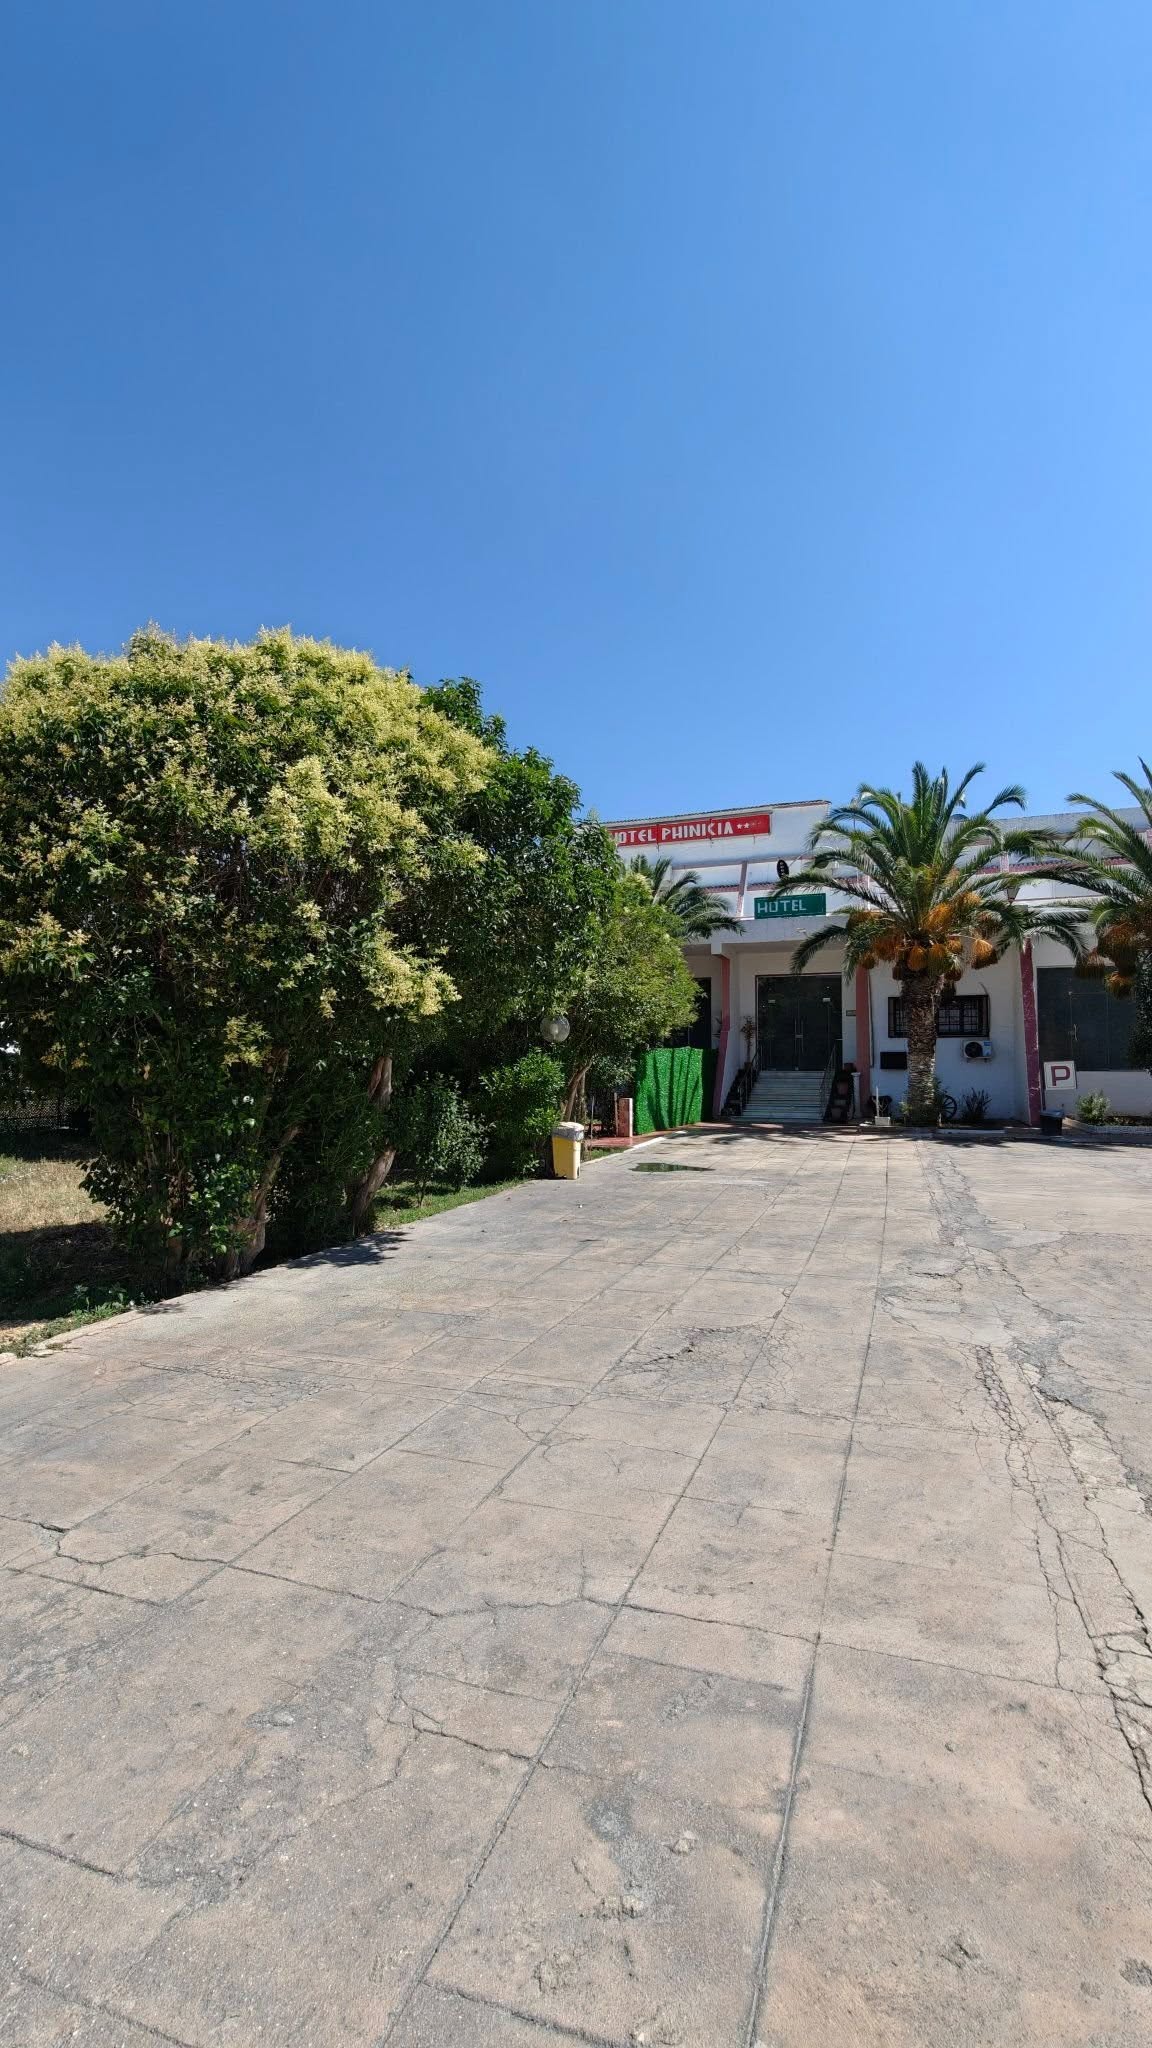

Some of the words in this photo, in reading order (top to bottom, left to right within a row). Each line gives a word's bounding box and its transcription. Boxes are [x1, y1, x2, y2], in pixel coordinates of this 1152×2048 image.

[661, 821, 734, 841] PHINICIA
[757, 899, 807, 914] HOTEL
[1050, 1065, 1071, 1087] P
